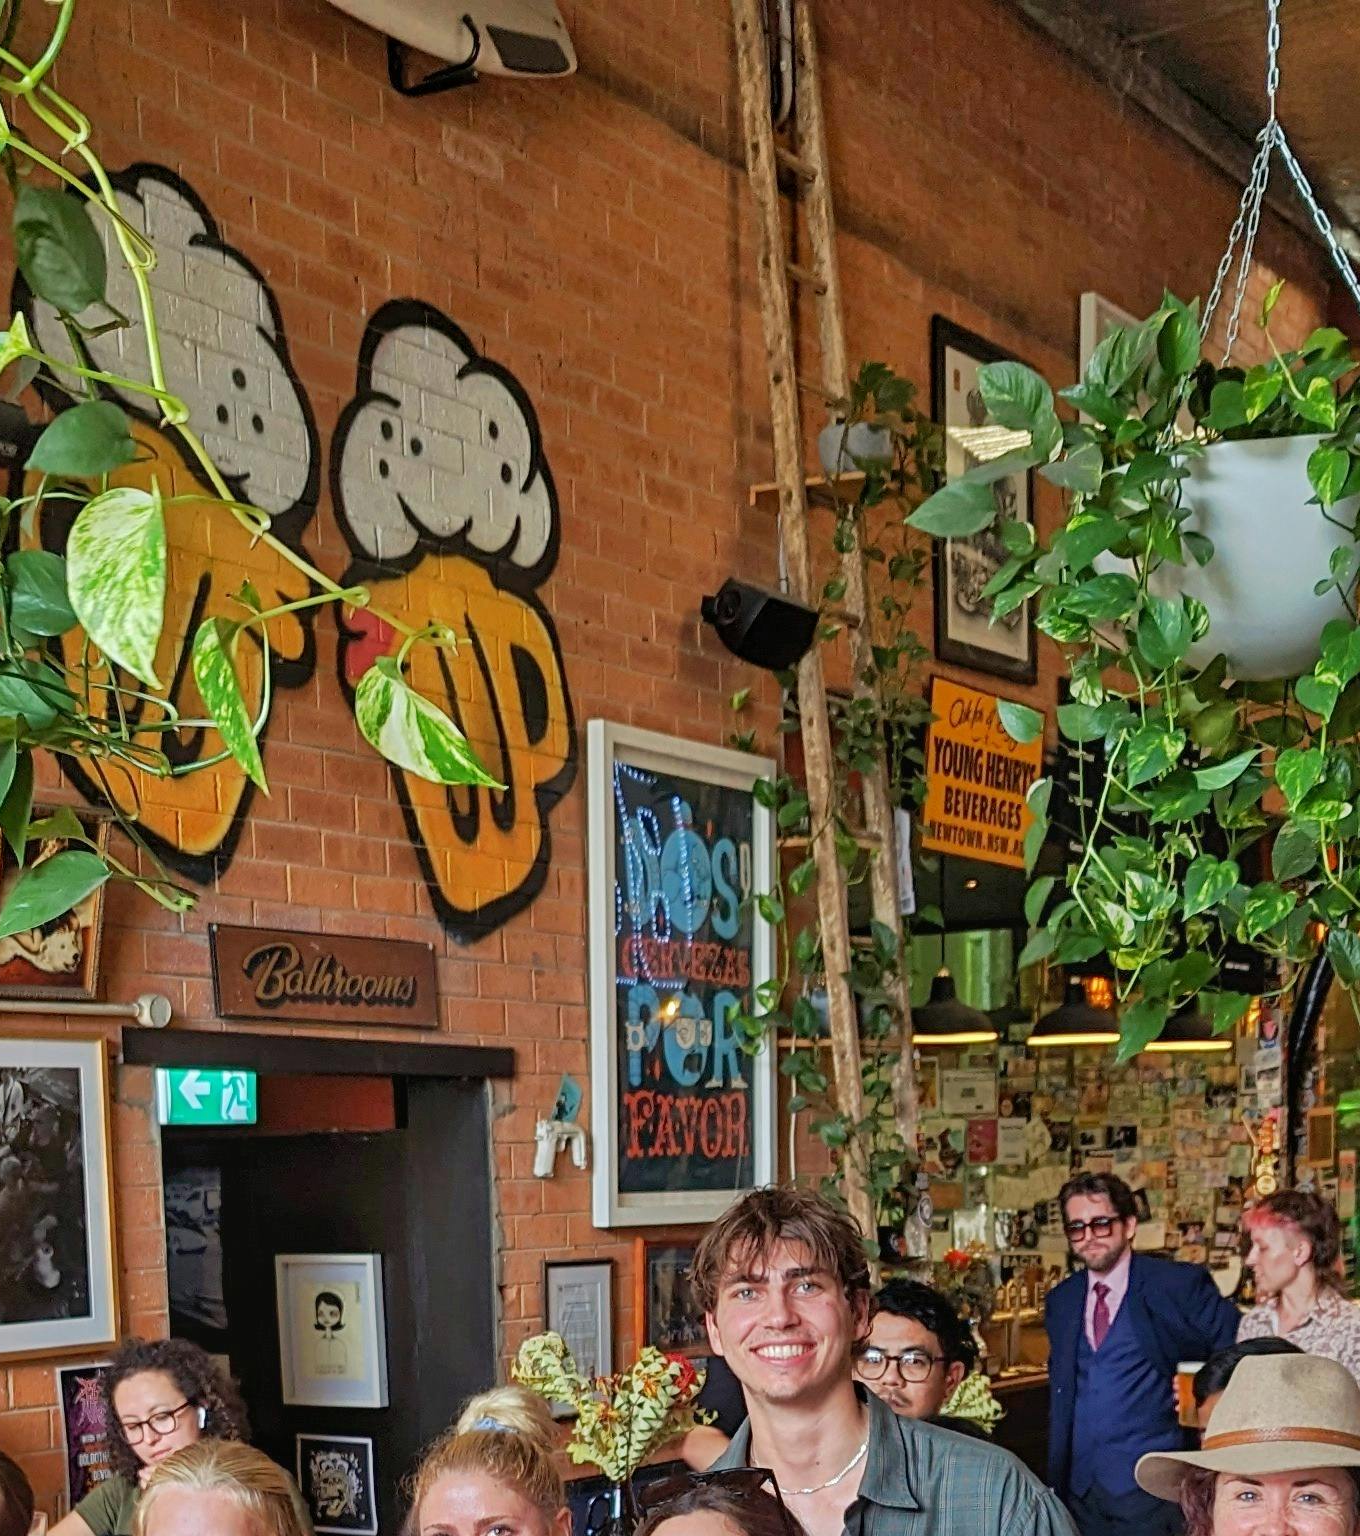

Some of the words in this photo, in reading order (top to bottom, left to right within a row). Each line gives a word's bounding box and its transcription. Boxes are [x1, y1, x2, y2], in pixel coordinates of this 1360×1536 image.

[933, 736, 983, 785] YOUNG
[943, 785, 1023, 832] BEVERAGES
[243, 941, 419, 1008] Bathrooms
[628, 984, 749, 1089] POR
[624, 1089, 750, 1159] FAVOR
